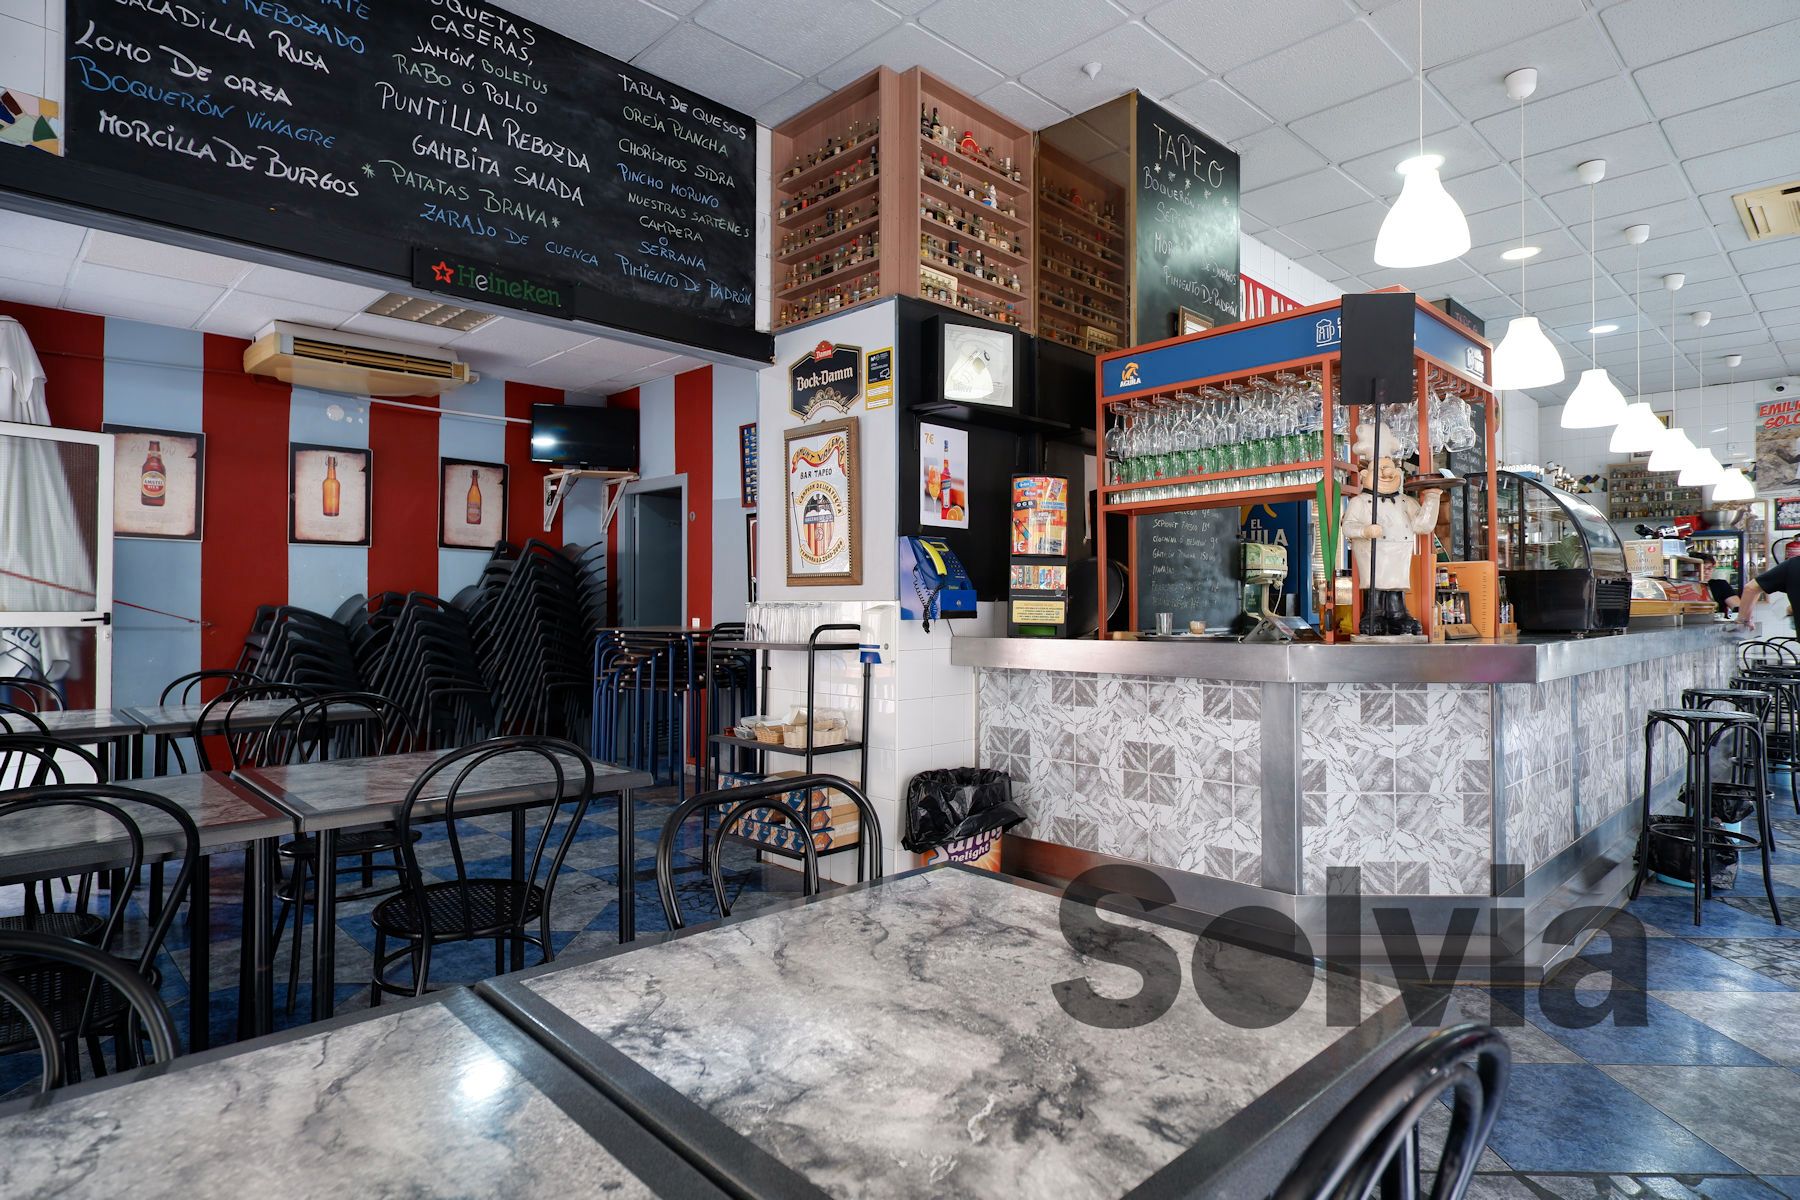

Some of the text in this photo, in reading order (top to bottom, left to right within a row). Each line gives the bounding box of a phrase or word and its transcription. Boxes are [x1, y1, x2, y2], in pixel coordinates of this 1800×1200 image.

[320, 0, 371, 20] ATE
[75, 20, 293, 107] LOMO DE ORZA
[268, 30, 330, 74] RUSA
[481, 58, 548, 95] BOLETUS
[69, 56, 337, 149] BOQUERÓN VINAGRE
[391, 54, 452, 87] RABO
[481, 81, 538, 115] POLLO
[617, 73, 747, 141] TABLA DE QUESOS
[374, 81, 591, 174] PUNTILLA REBOZDA
[622, 105, 729, 158] OREJA PLANCHA
[99, 109, 360, 197] MORCILLA DE BURGOS
[412, 134, 585, 207] GAMBITA SALADA
[693, 164, 736, 189] SIDRA
[1152, 122, 1225, 189] TAPEO
[378, 159, 470, 201] PATATAS
[616, 162, 720, 209] PINCHO MORUNO
[419, 202, 600, 267] ZARAJO DE CUENCA
[627, 192, 750, 238] NUESTRAS SARTENES
[638, 215, 704, 242] CAMPERA
[614, 252, 753, 306] PIMIENTO DE PADRÓN
[638, 241, 707, 272] SERRANA
[457, 264, 561, 307] Heineken
[924, 432, 935, 445] 7€
